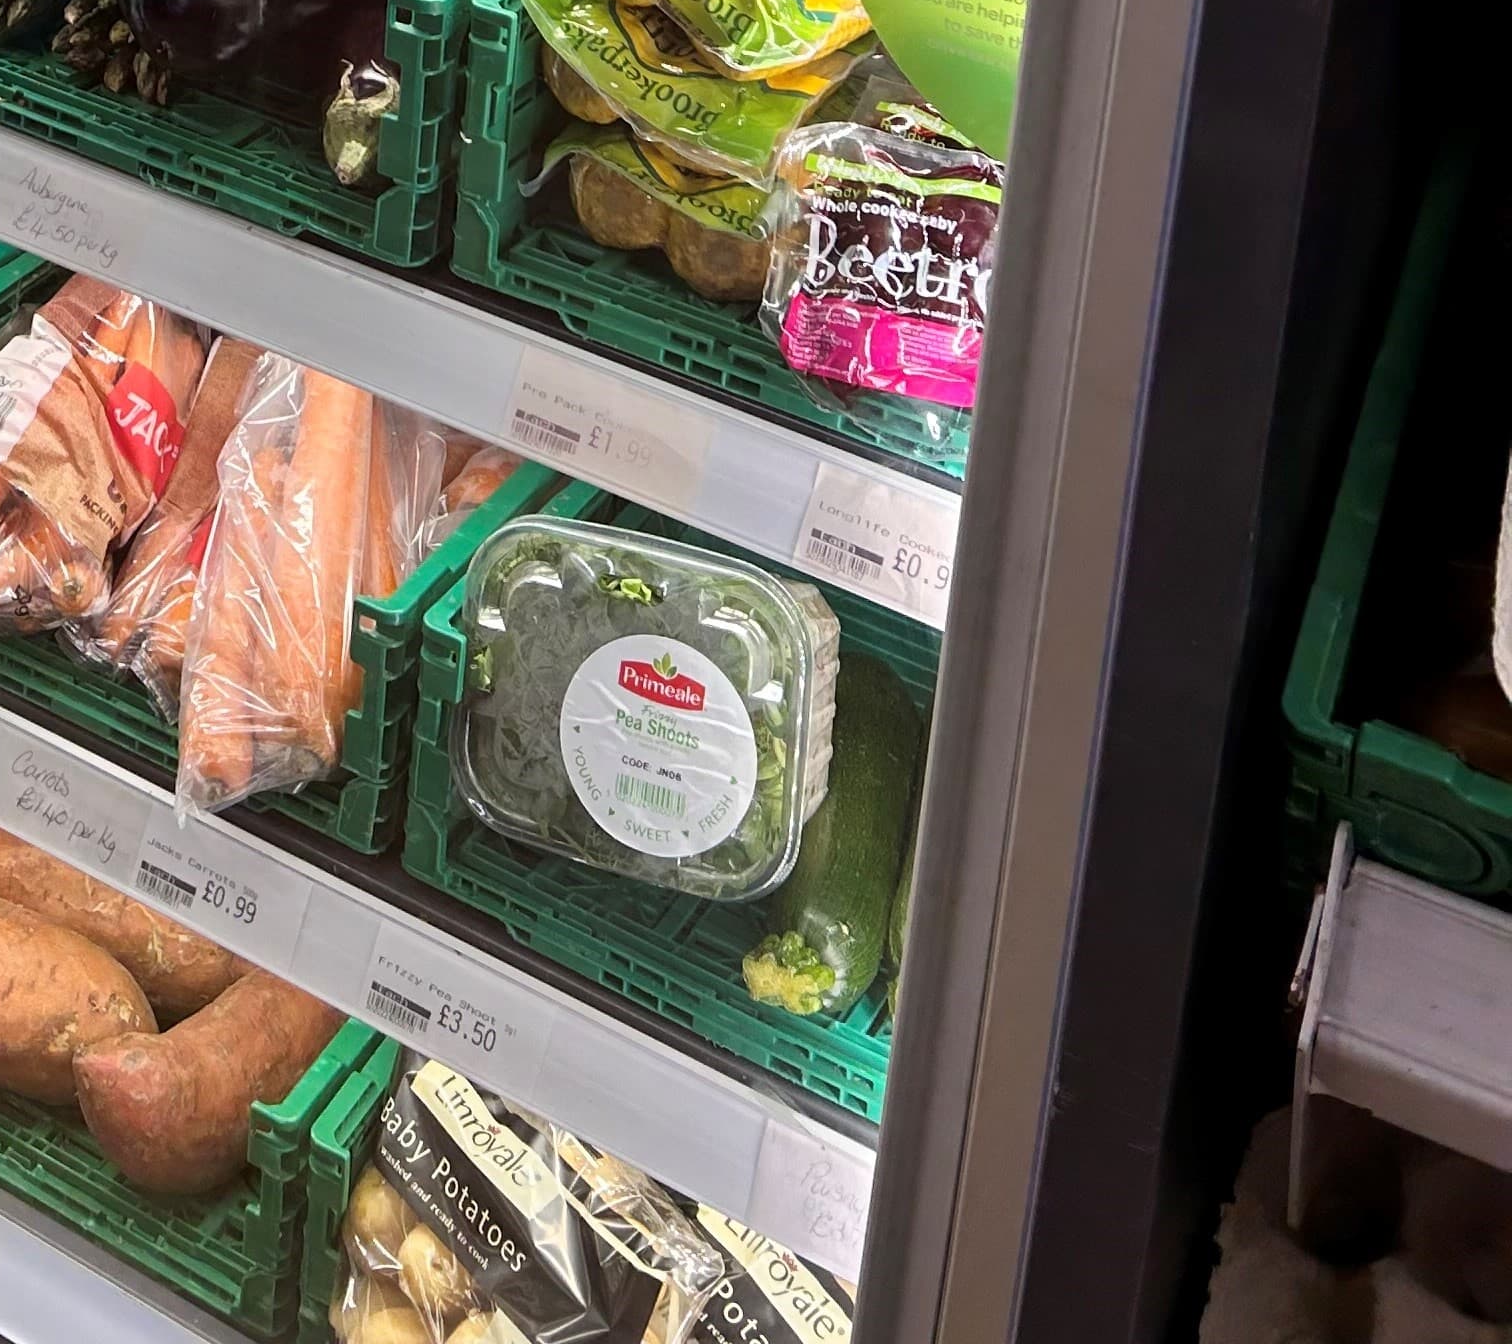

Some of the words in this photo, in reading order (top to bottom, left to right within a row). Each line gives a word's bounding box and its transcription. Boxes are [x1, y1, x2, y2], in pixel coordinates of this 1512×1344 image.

[944, 17, 962, 33] to
[965, 23, 1006, 44] save
[812, 196, 857, 213] Whole
[588, 424, 654, 470] £1.99
[819, 500, 890, 539] Longlife
[624, 665, 701, 707] Primeale
[616, 708, 643, 731] Pea
[647, 717, 700, 750] Shoots
[11, 749, 70, 799] Carrots
[573, 746, 602, 802] YOUNG
[68, 820, 95, 841] per
[624, 818, 672, 843] SWEET
[698, 792, 734, 833] FRESH
[147, 838, 182, 861] Jacks
[188, 857, 237, 889] Carrots
[201, 879, 257, 924] £0.99
[378, 955, 423, 987] Frizzy
[428, 983, 452, 1002] Pea
[458, 999, 496, 1027] Shoot
[437, 1004, 497, 1052] £3.50
[379, 1096, 432, 1163] Baby
[431, 1157, 527, 1273] Potatoes
[380, 1145, 413, 1181] washed
[409, 1178, 430, 1203] and
[430, 1203, 457, 1234] ready
[456, 1230, 470, 1247] to
[468, 1241, 489, 1271] cook
